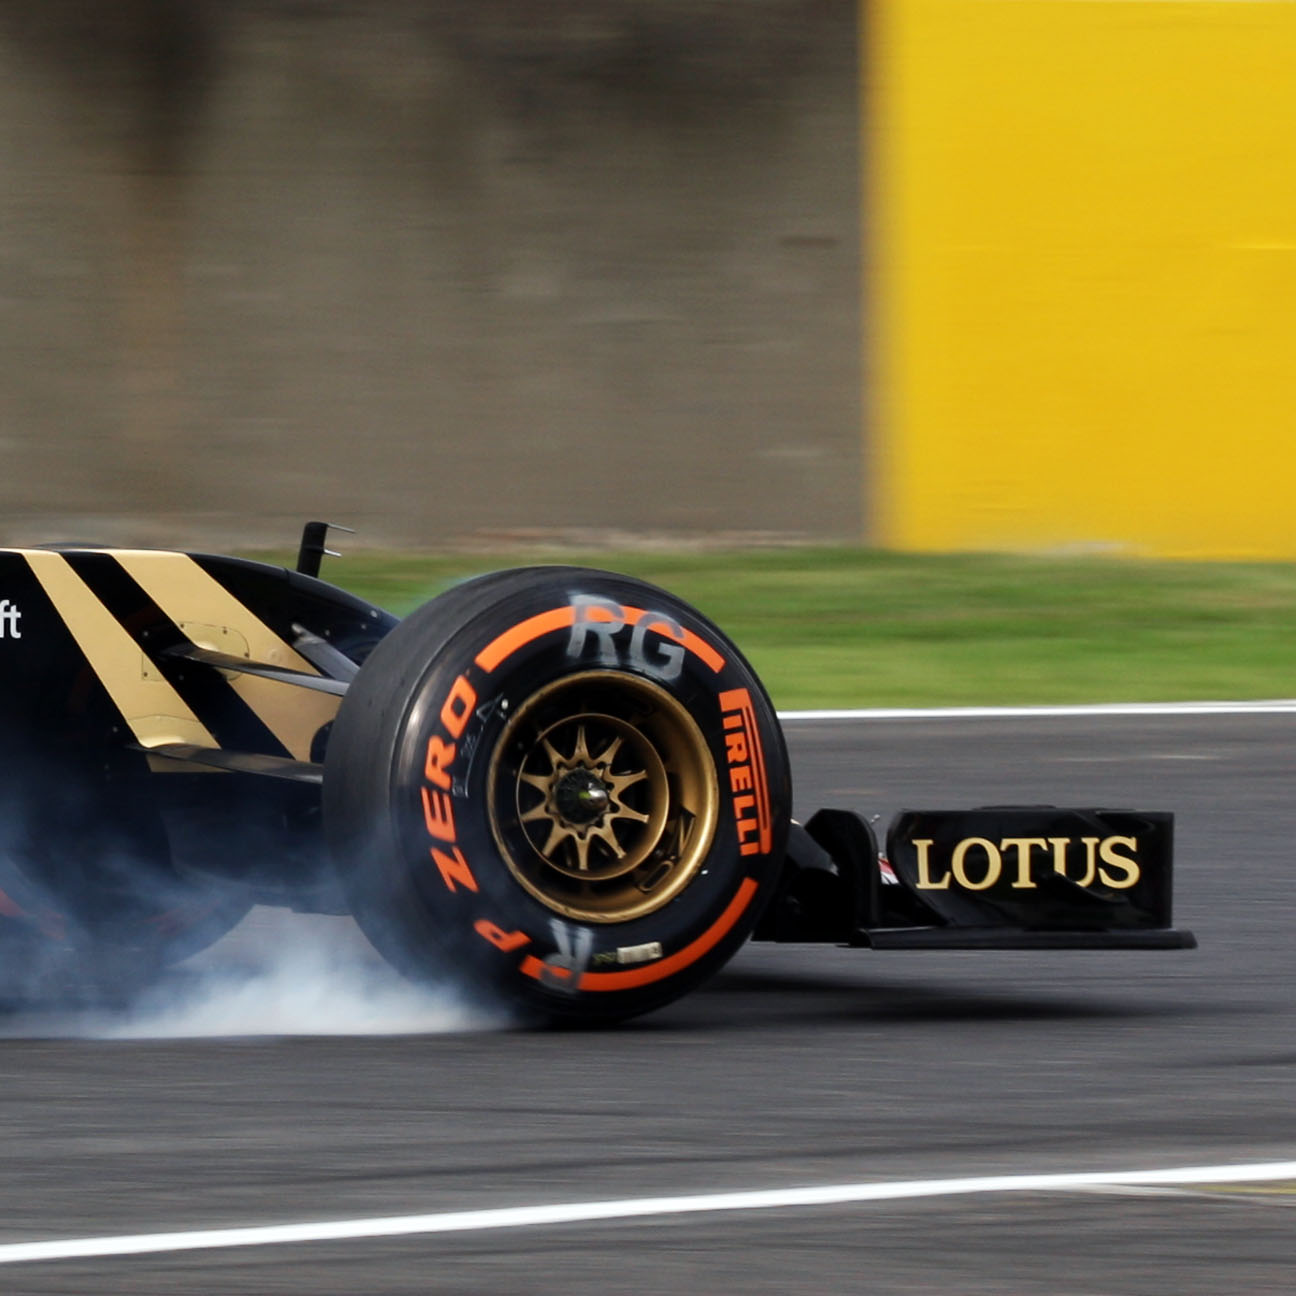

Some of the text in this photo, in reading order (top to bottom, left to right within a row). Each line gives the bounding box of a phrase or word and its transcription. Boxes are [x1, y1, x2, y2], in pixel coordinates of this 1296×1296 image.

[565, 590, 688, 681] RG
[420, 674, 479, 894] ZERO
[718, 686, 772, 857] PIRELLI
[911, 835, 1141, 891] LOTUS
